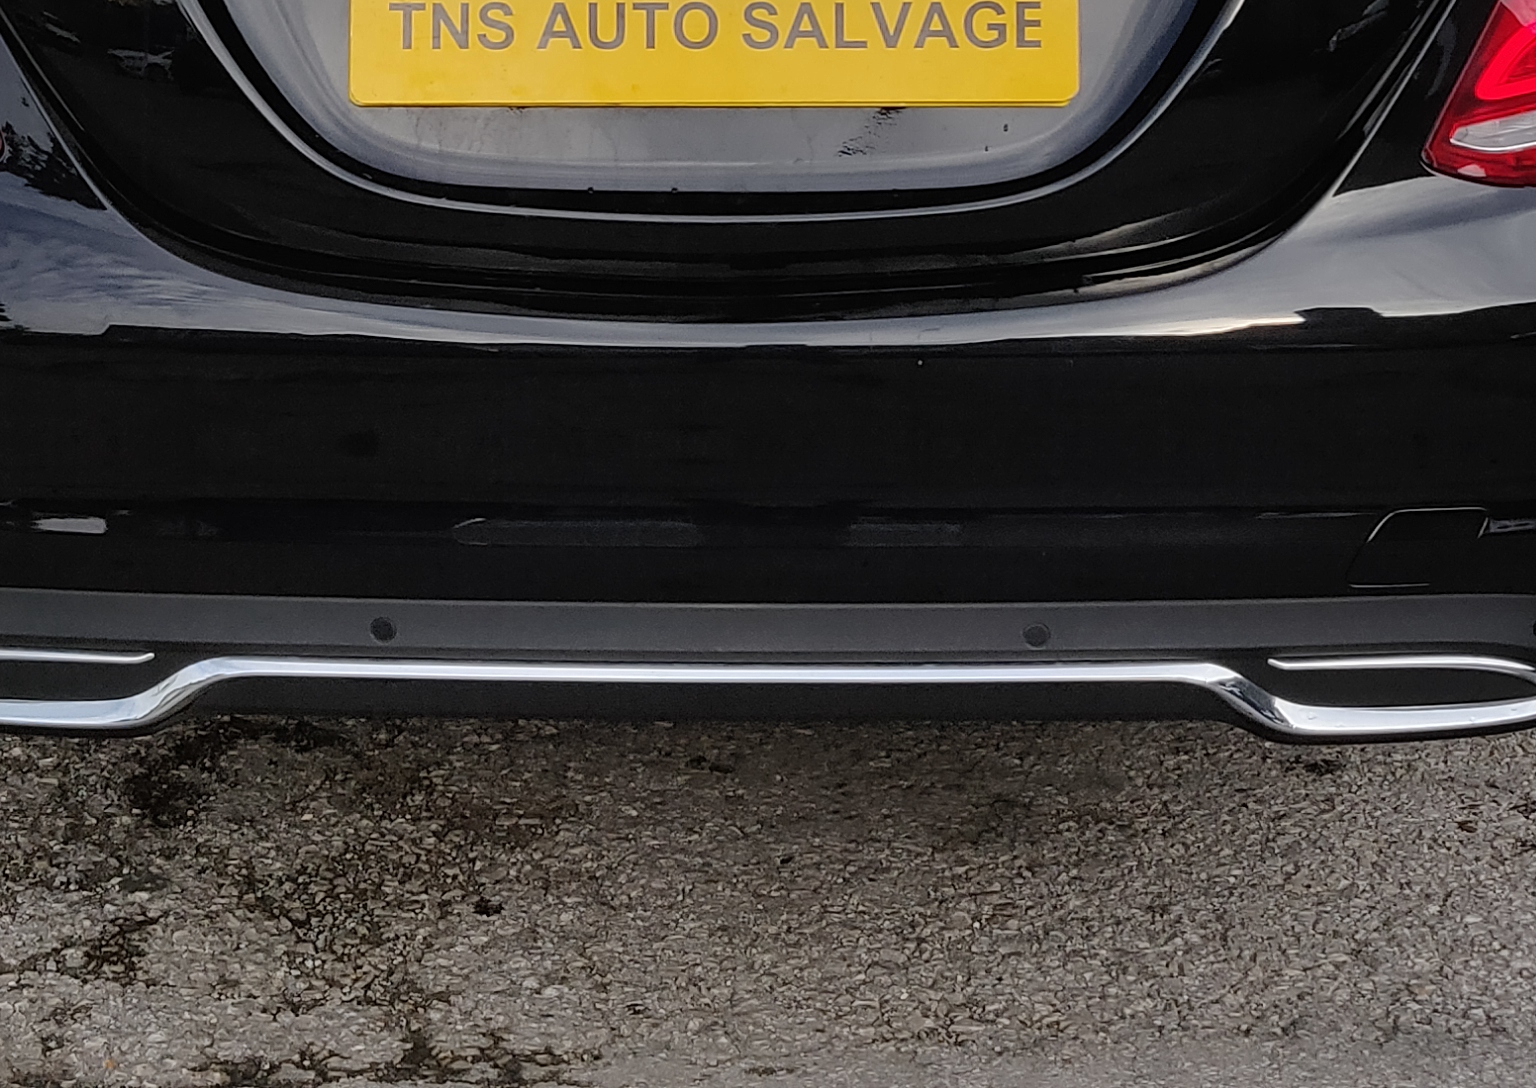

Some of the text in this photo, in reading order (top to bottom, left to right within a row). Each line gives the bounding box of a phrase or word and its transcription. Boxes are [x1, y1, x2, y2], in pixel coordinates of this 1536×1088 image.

[388, 0, 1043, 51] TNS AUTO SALVAGE
